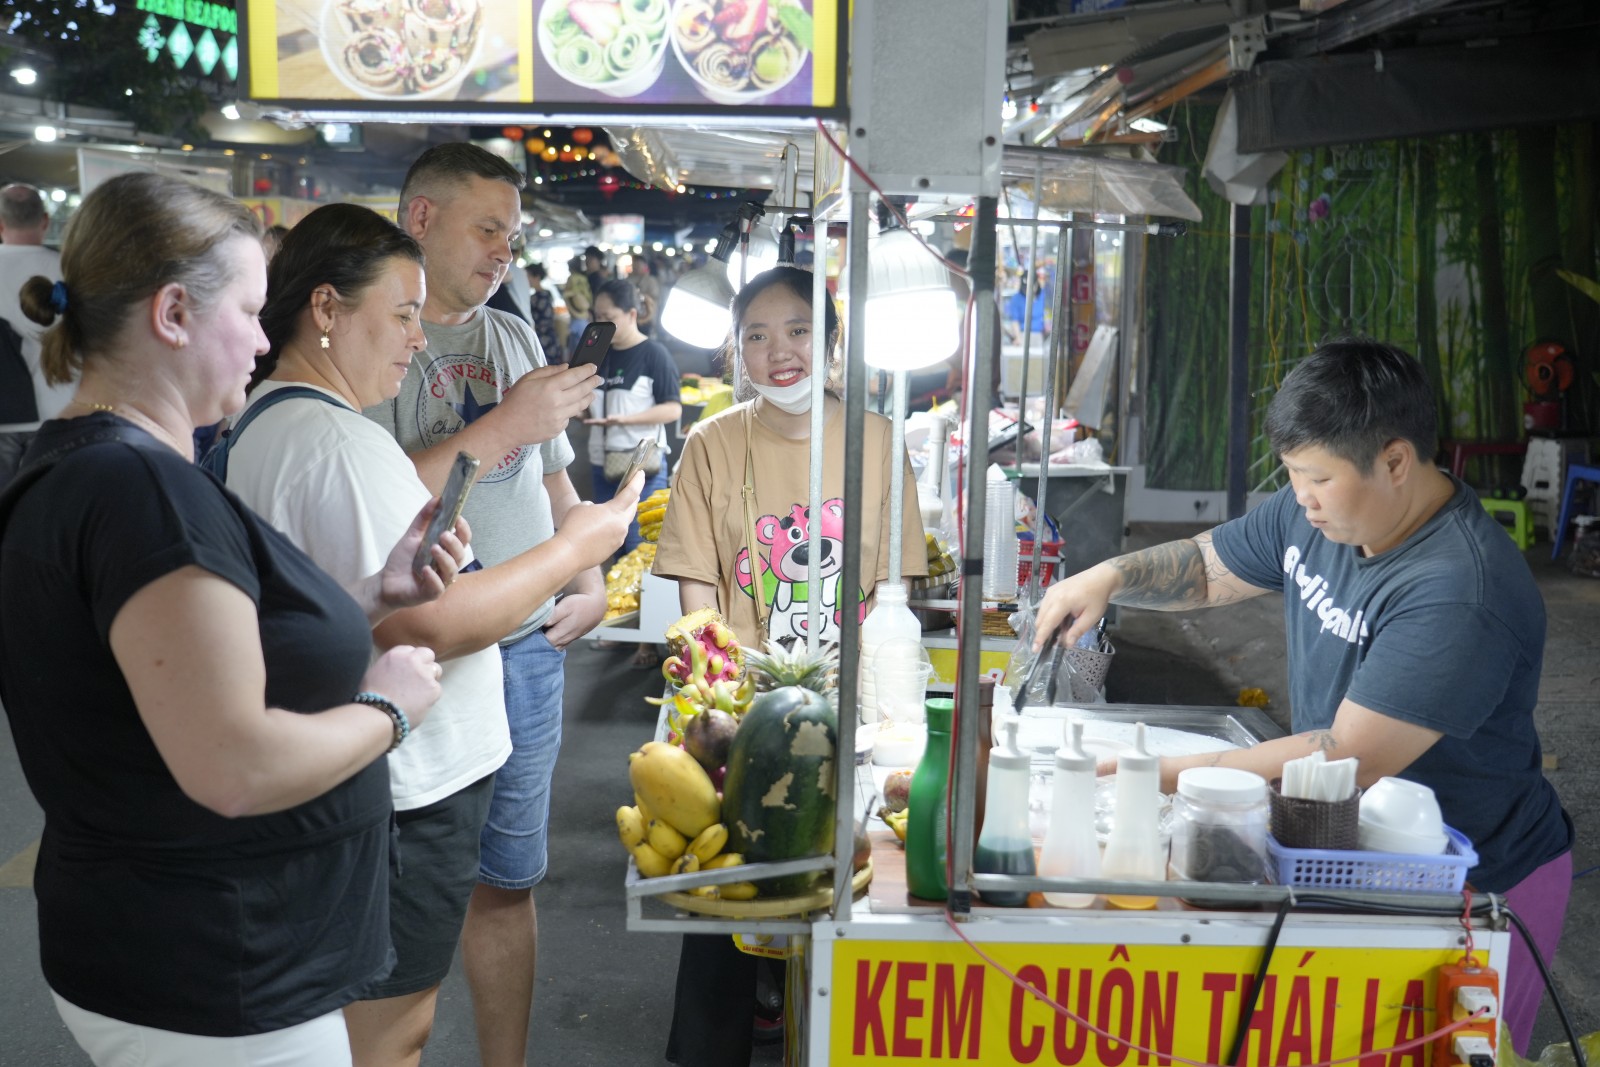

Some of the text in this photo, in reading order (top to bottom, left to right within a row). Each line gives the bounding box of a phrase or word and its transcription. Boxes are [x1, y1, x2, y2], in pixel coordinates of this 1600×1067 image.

[431, 363, 511, 399] CONVER
[852, 959, 985, 1060] KEM
[1008, 944, 1179, 1067] CUÔN
[1203, 951, 1339, 1067] THÁI
